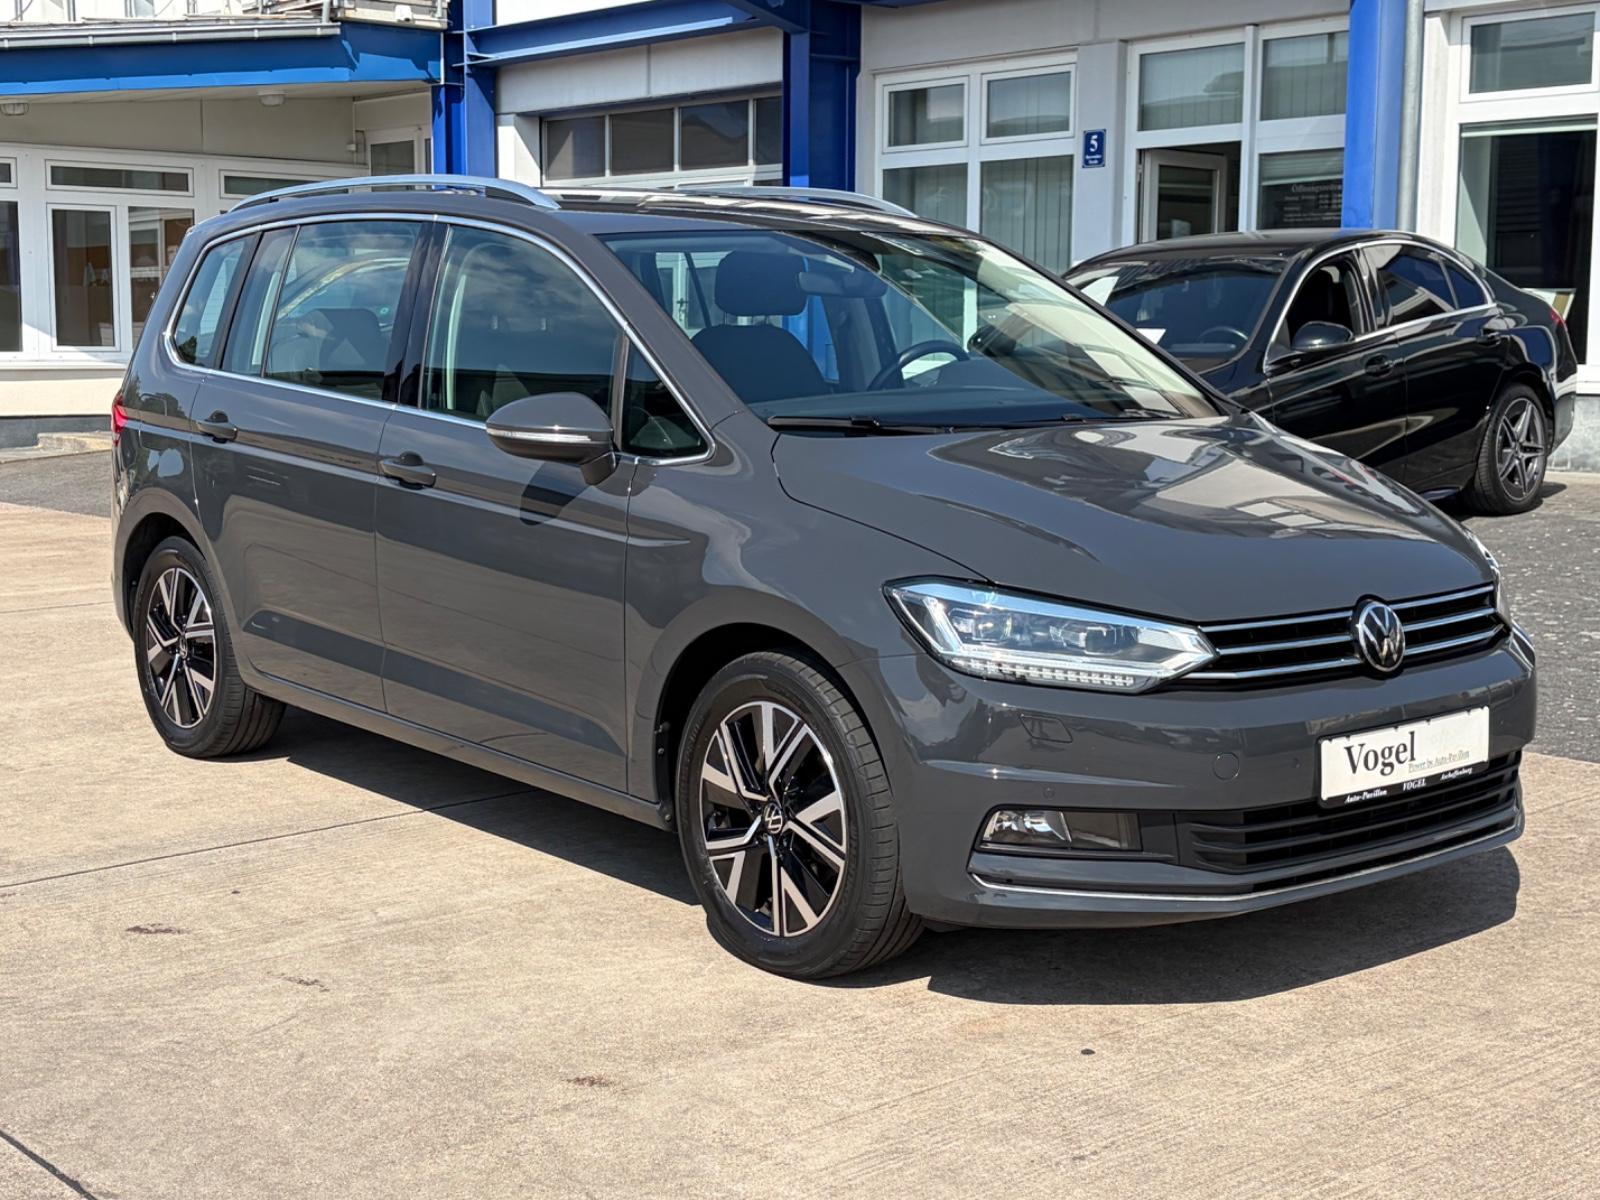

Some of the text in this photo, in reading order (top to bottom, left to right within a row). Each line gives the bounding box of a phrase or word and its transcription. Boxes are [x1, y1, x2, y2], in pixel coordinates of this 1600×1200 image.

[1090, 134, 1098, 152] 5
[1344, 731, 1416, 776] Vogel
[1402, 778, 1427, 792] VOGEL
